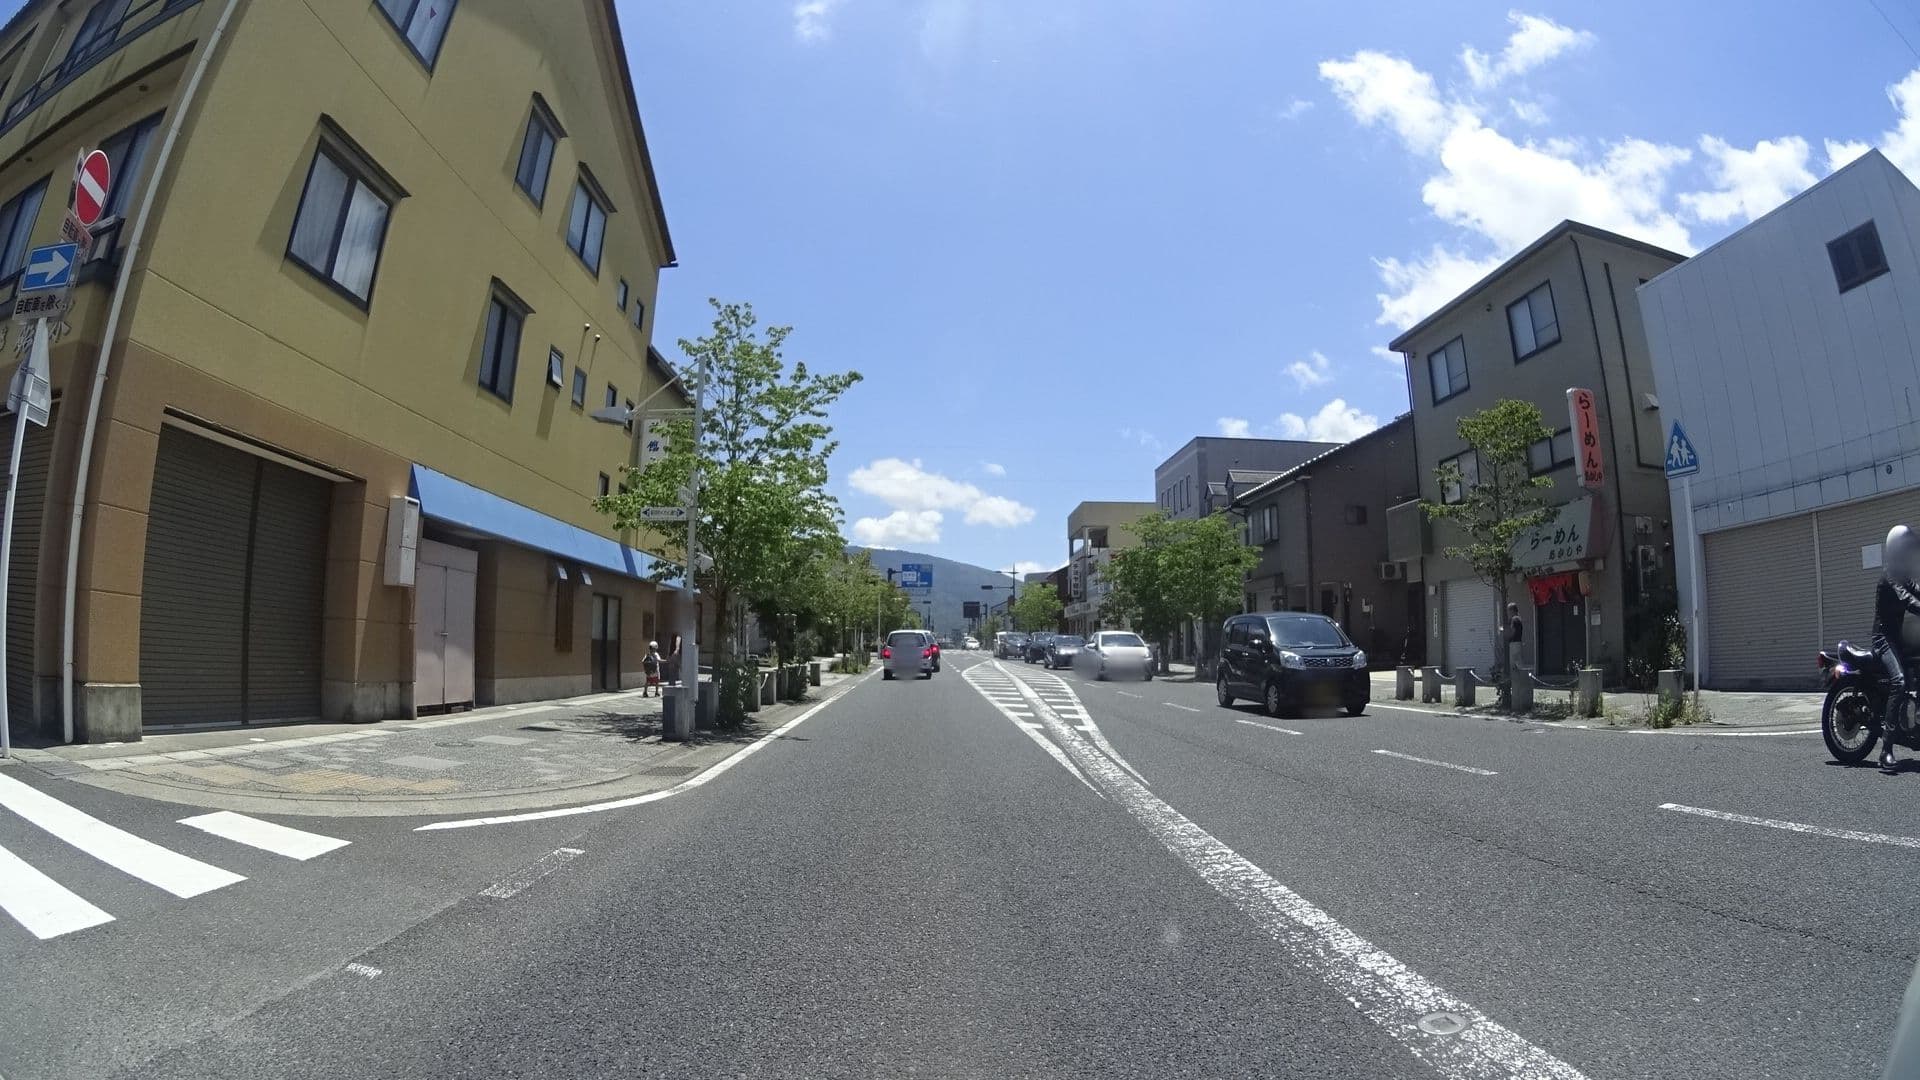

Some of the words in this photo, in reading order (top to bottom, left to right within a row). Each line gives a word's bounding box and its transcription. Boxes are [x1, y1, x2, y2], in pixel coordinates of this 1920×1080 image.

[15, 294, 62, 314] 自転車を除く
[1578, 392, 1598, 468] らーめん
[1530, 524, 1579, 550] らーめん
